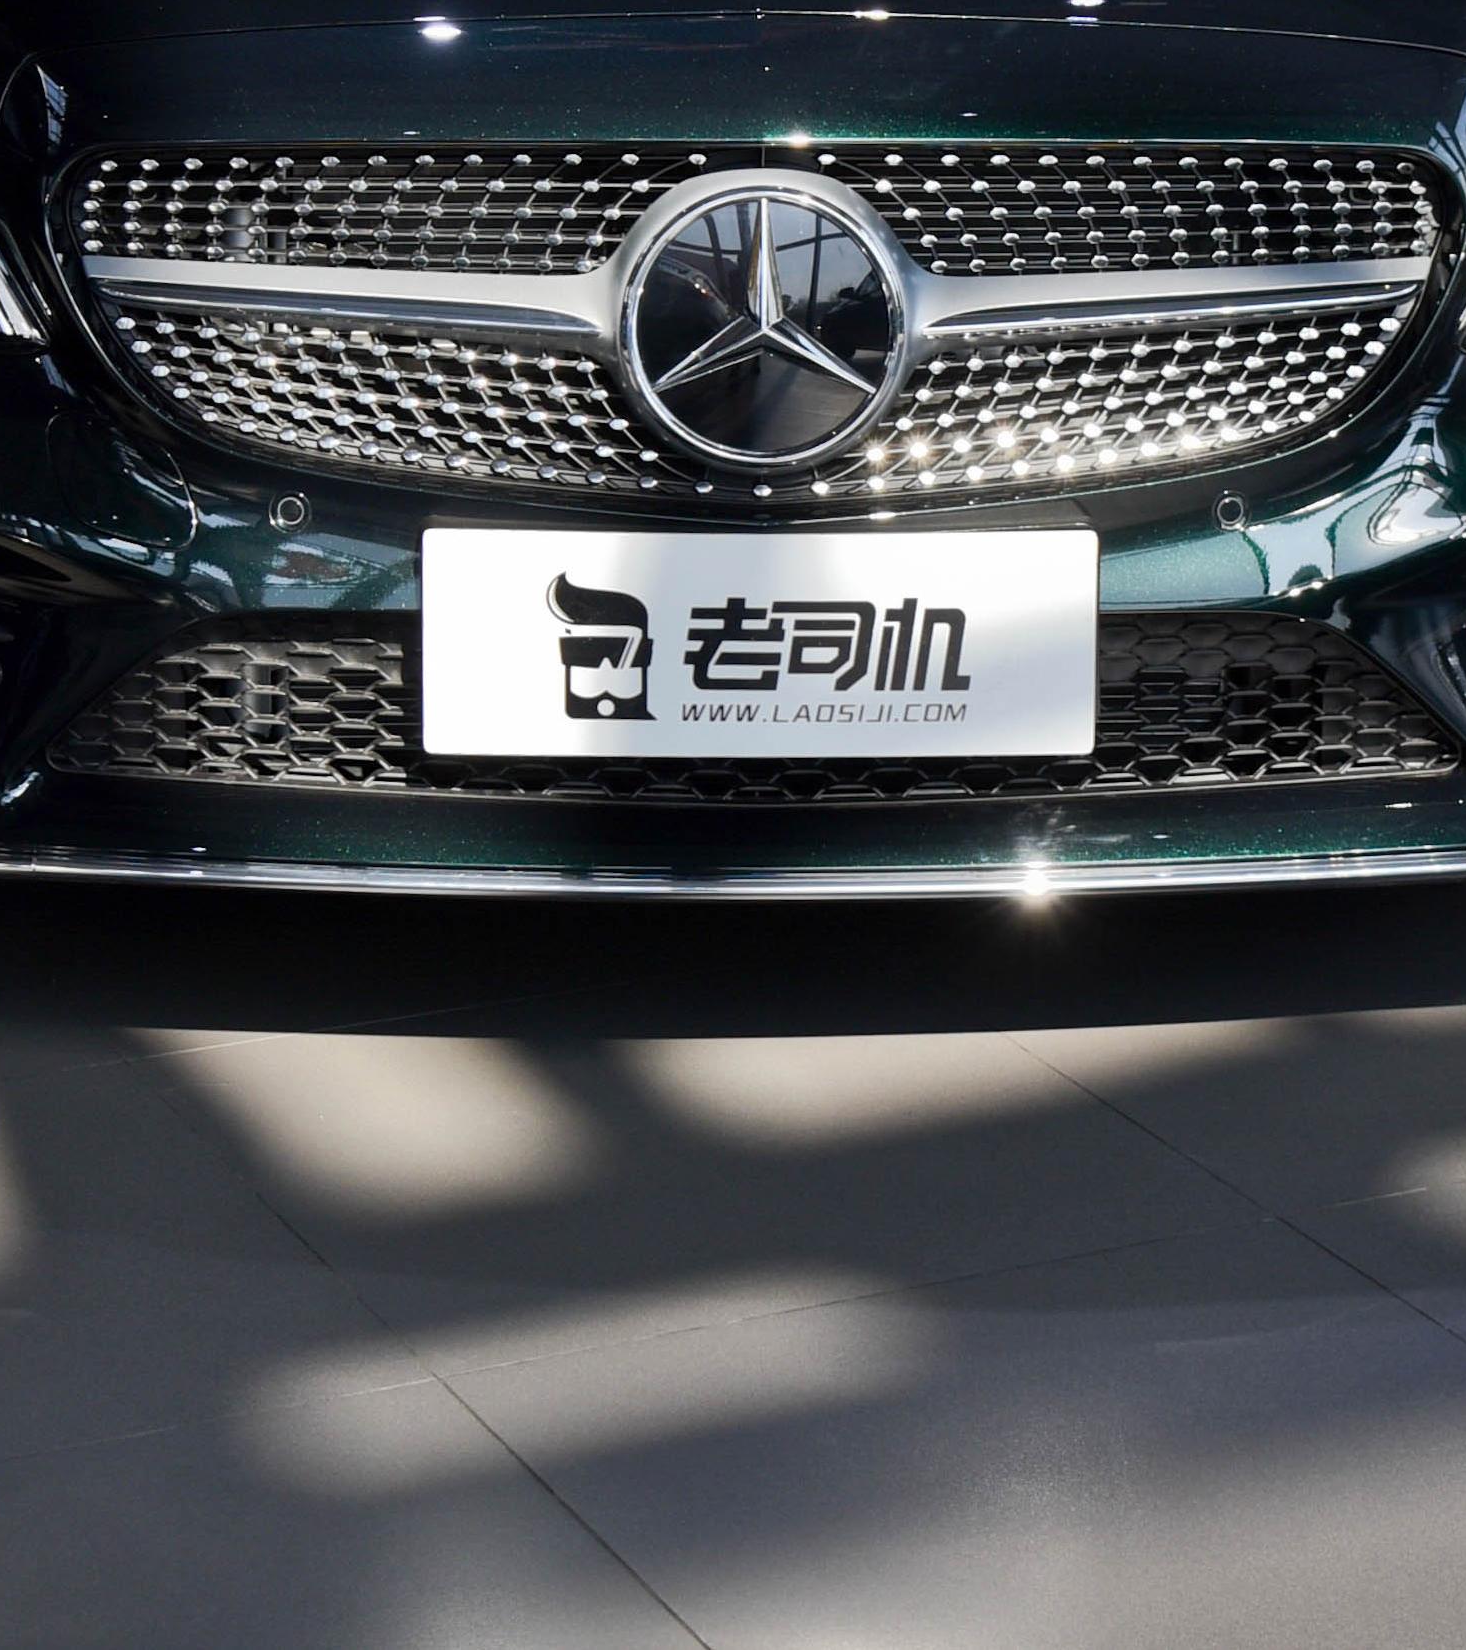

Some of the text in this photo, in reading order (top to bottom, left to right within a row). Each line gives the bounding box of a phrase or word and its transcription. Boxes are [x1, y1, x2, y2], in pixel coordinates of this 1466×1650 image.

[684, 597, 971, 691] 老司机
[682, 703, 967, 723] WWW.LAOSIJI.COM
